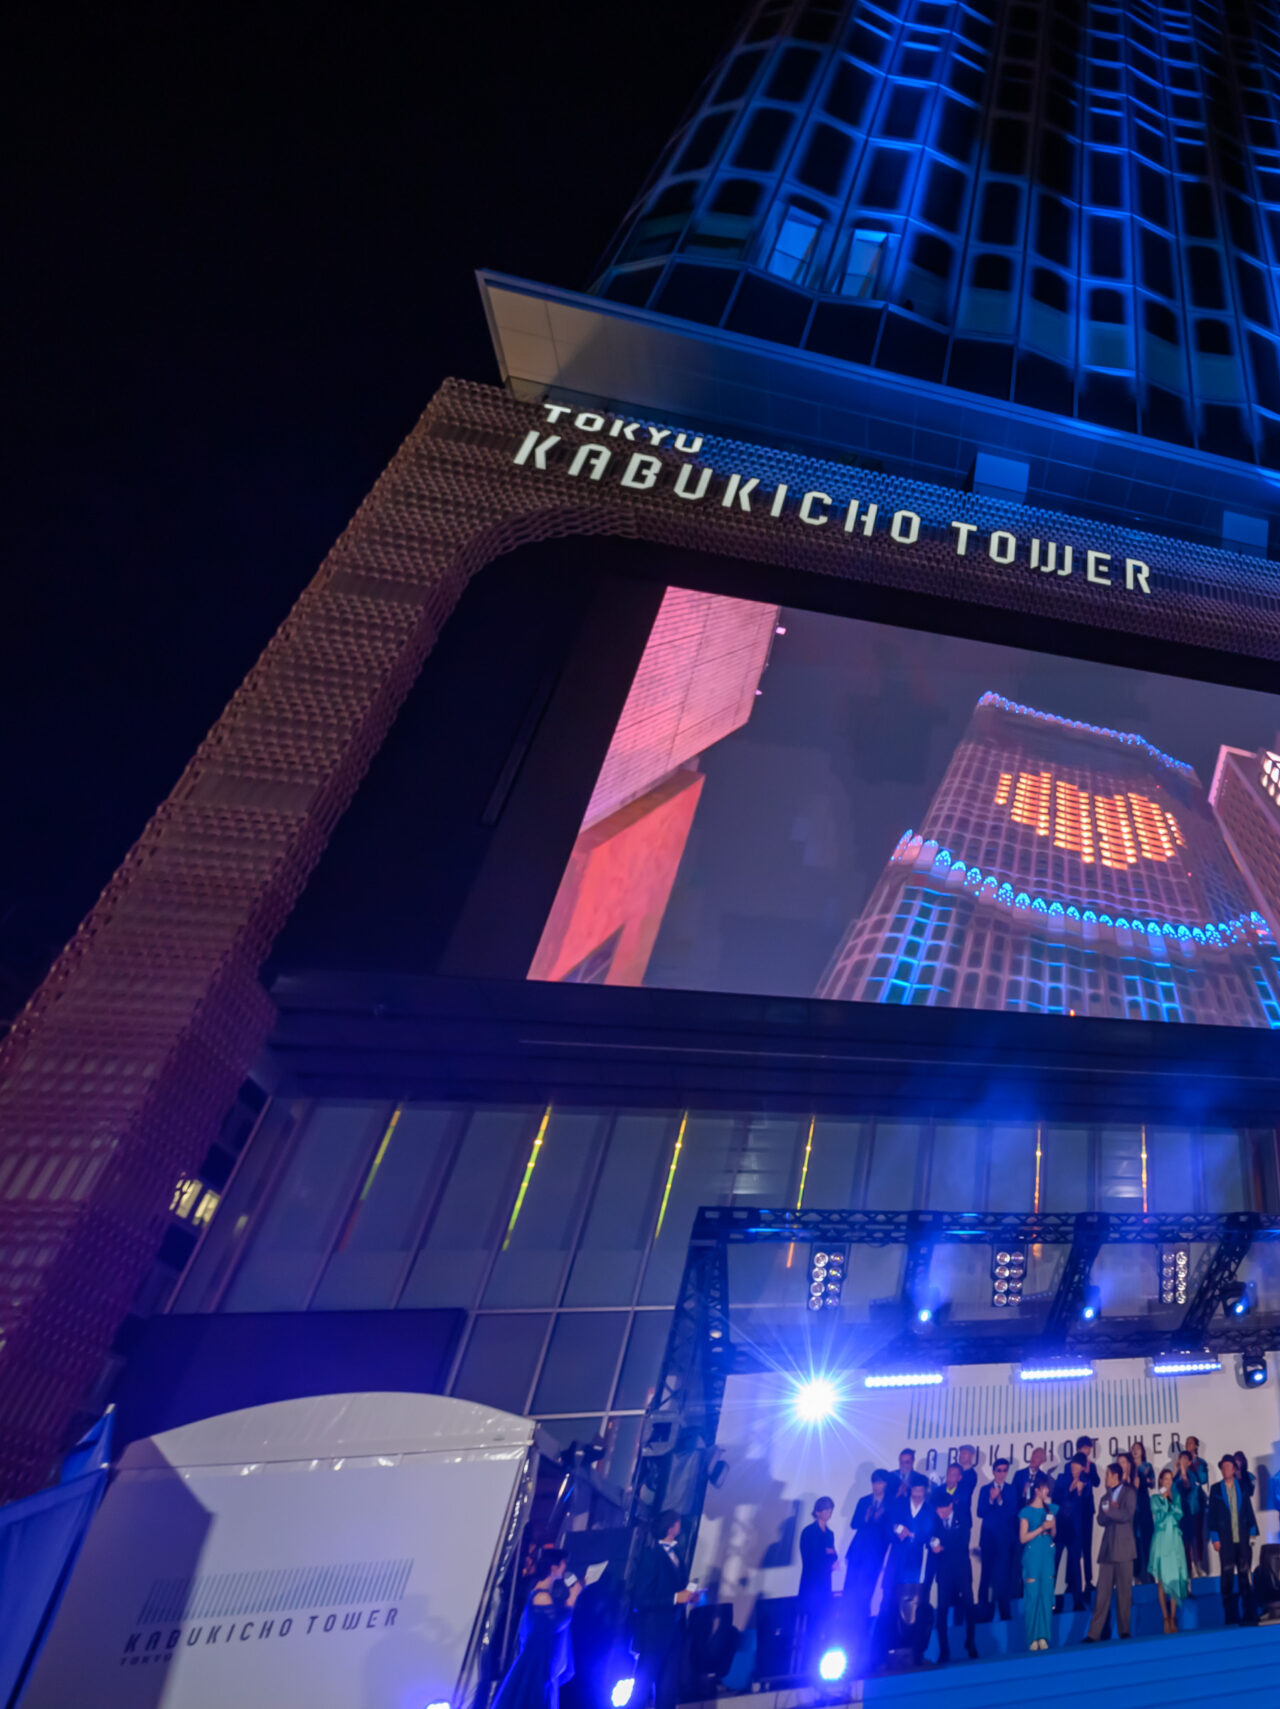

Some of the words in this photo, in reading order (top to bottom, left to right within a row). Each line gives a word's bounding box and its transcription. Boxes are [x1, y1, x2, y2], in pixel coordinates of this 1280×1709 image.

[543, 403, 705, 454] TOKYU
[513, 430, 921, 545] KABUKICHO
[951, 520, 1153, 595] TOWER
[123, 1617, 294, 1654] KABUKICHO
[306, 1607, 399, 1635] TOWER
